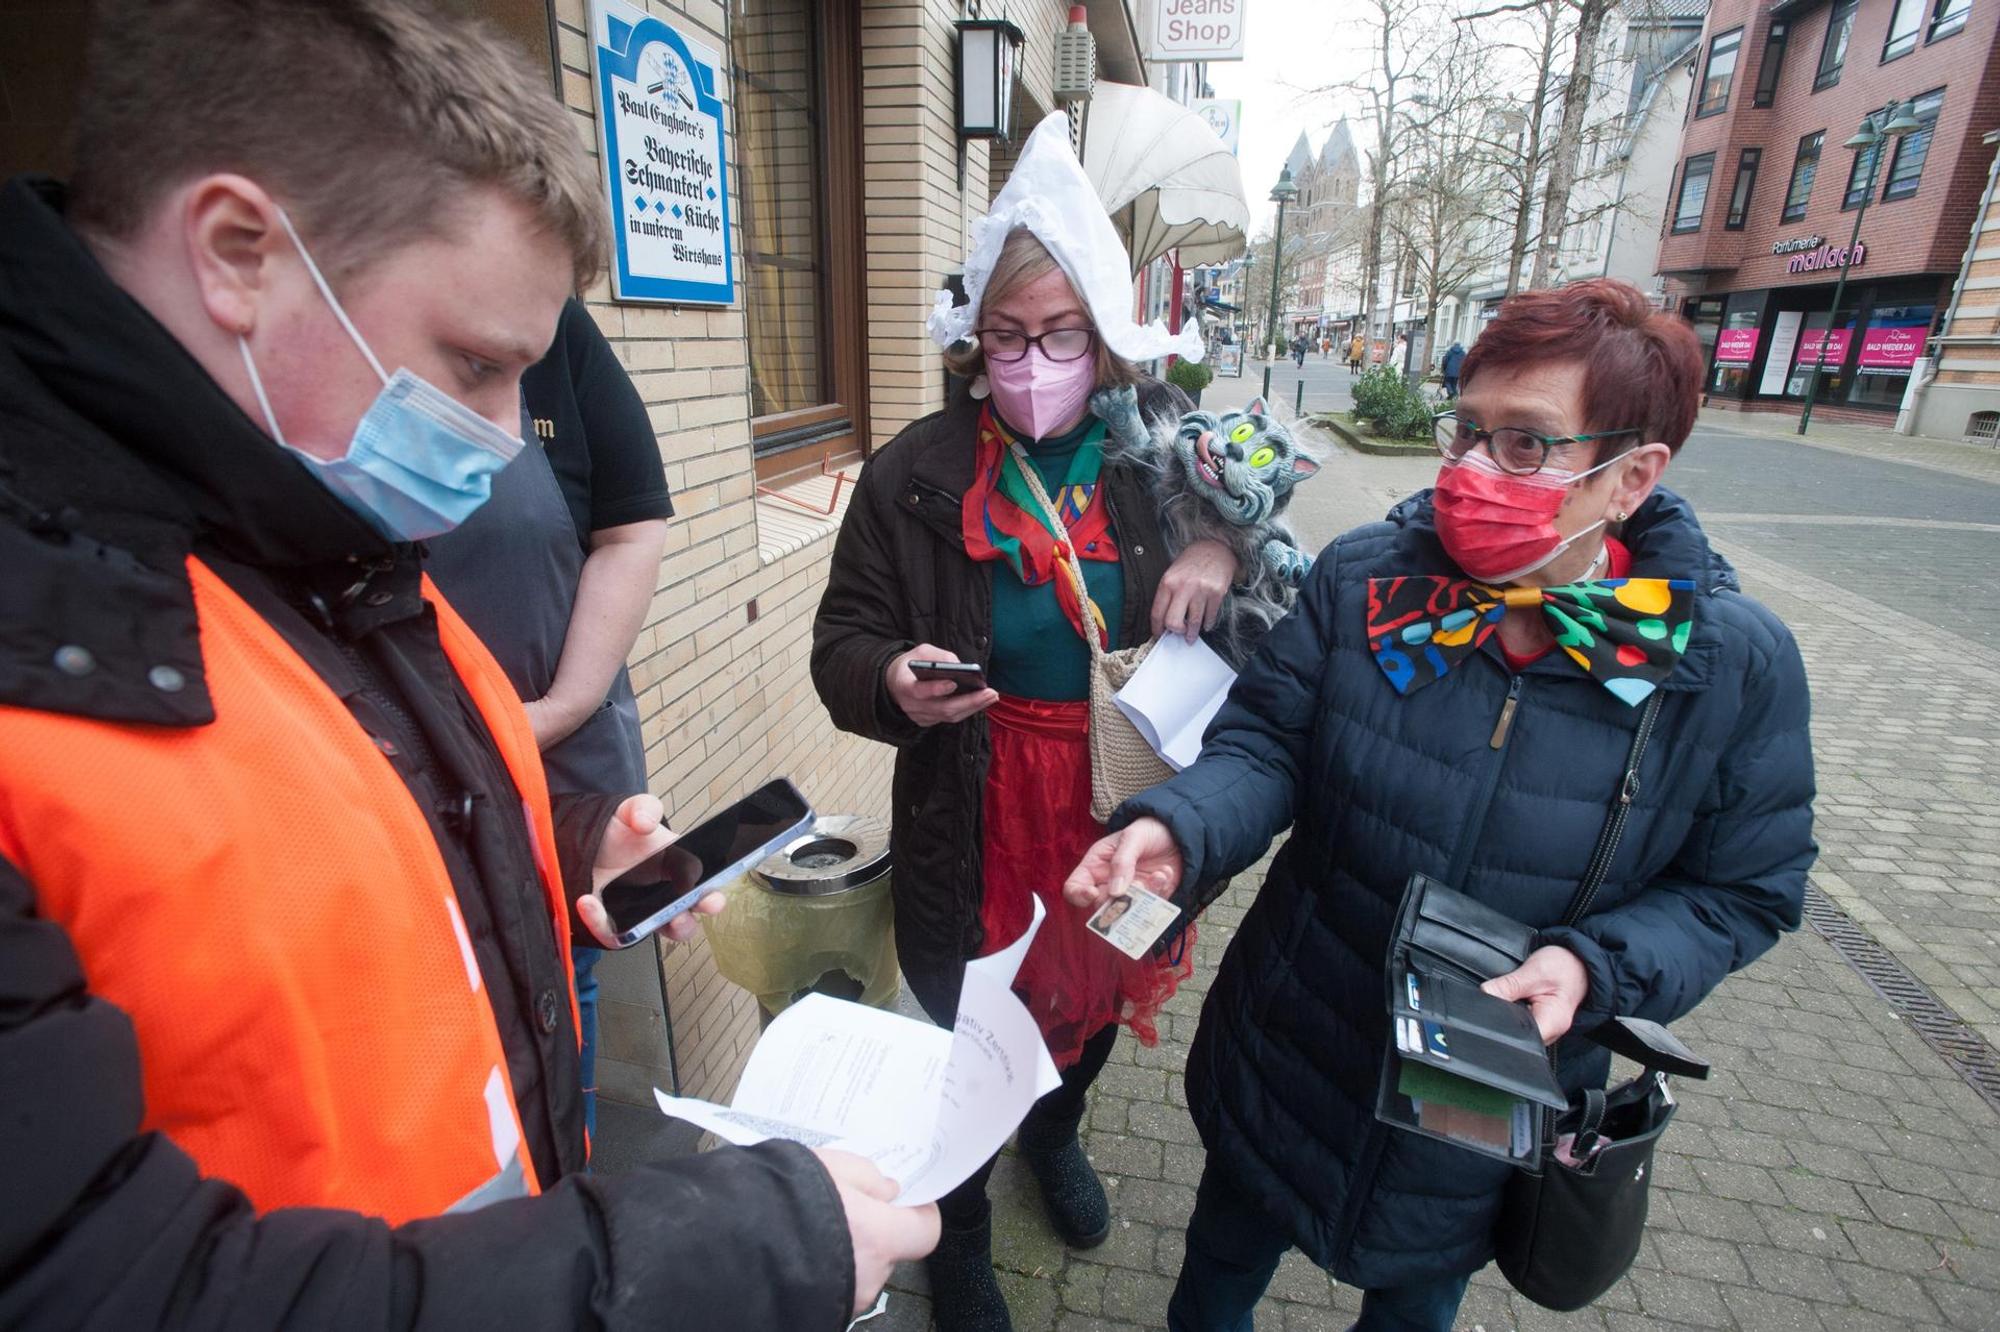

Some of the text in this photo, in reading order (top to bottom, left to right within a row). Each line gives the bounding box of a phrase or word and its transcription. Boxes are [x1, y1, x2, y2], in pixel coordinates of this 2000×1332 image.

[1167, 0, 1235, 15] Jeans
[1168, 20, 1231, 44] Shop
[618, 90, 649, 119] Paul
[644, 135, 713, 181] Bayerische
[625, 158, 703, 202] Schmankerl
[629, 214, 683, 241] in unserem
[684, 204, 720, 236] Küche
[672, 243, 722, 268] Wirtshaus
